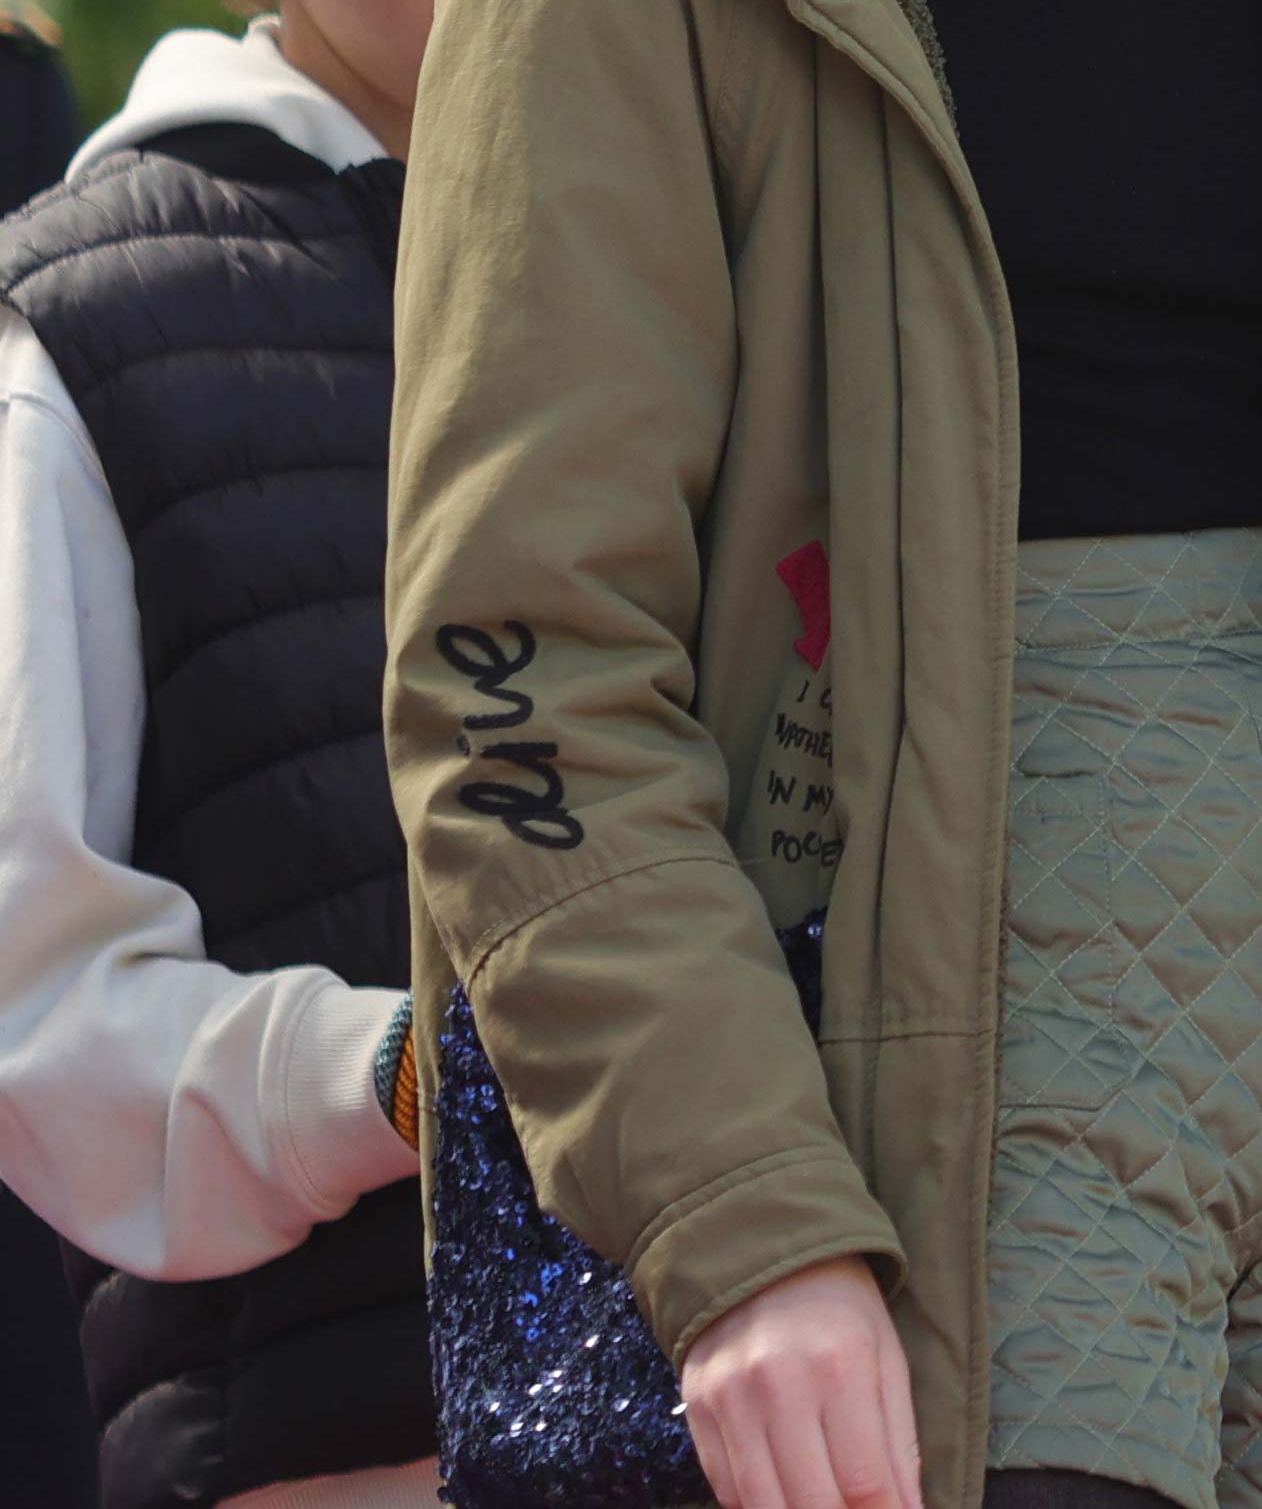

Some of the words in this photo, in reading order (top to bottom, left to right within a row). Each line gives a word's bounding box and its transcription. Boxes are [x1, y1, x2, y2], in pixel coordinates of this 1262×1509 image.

[796, 680, 810, 703] I
[767, 769, 797, 805] IN
[801, 784, 834, 816] MY
